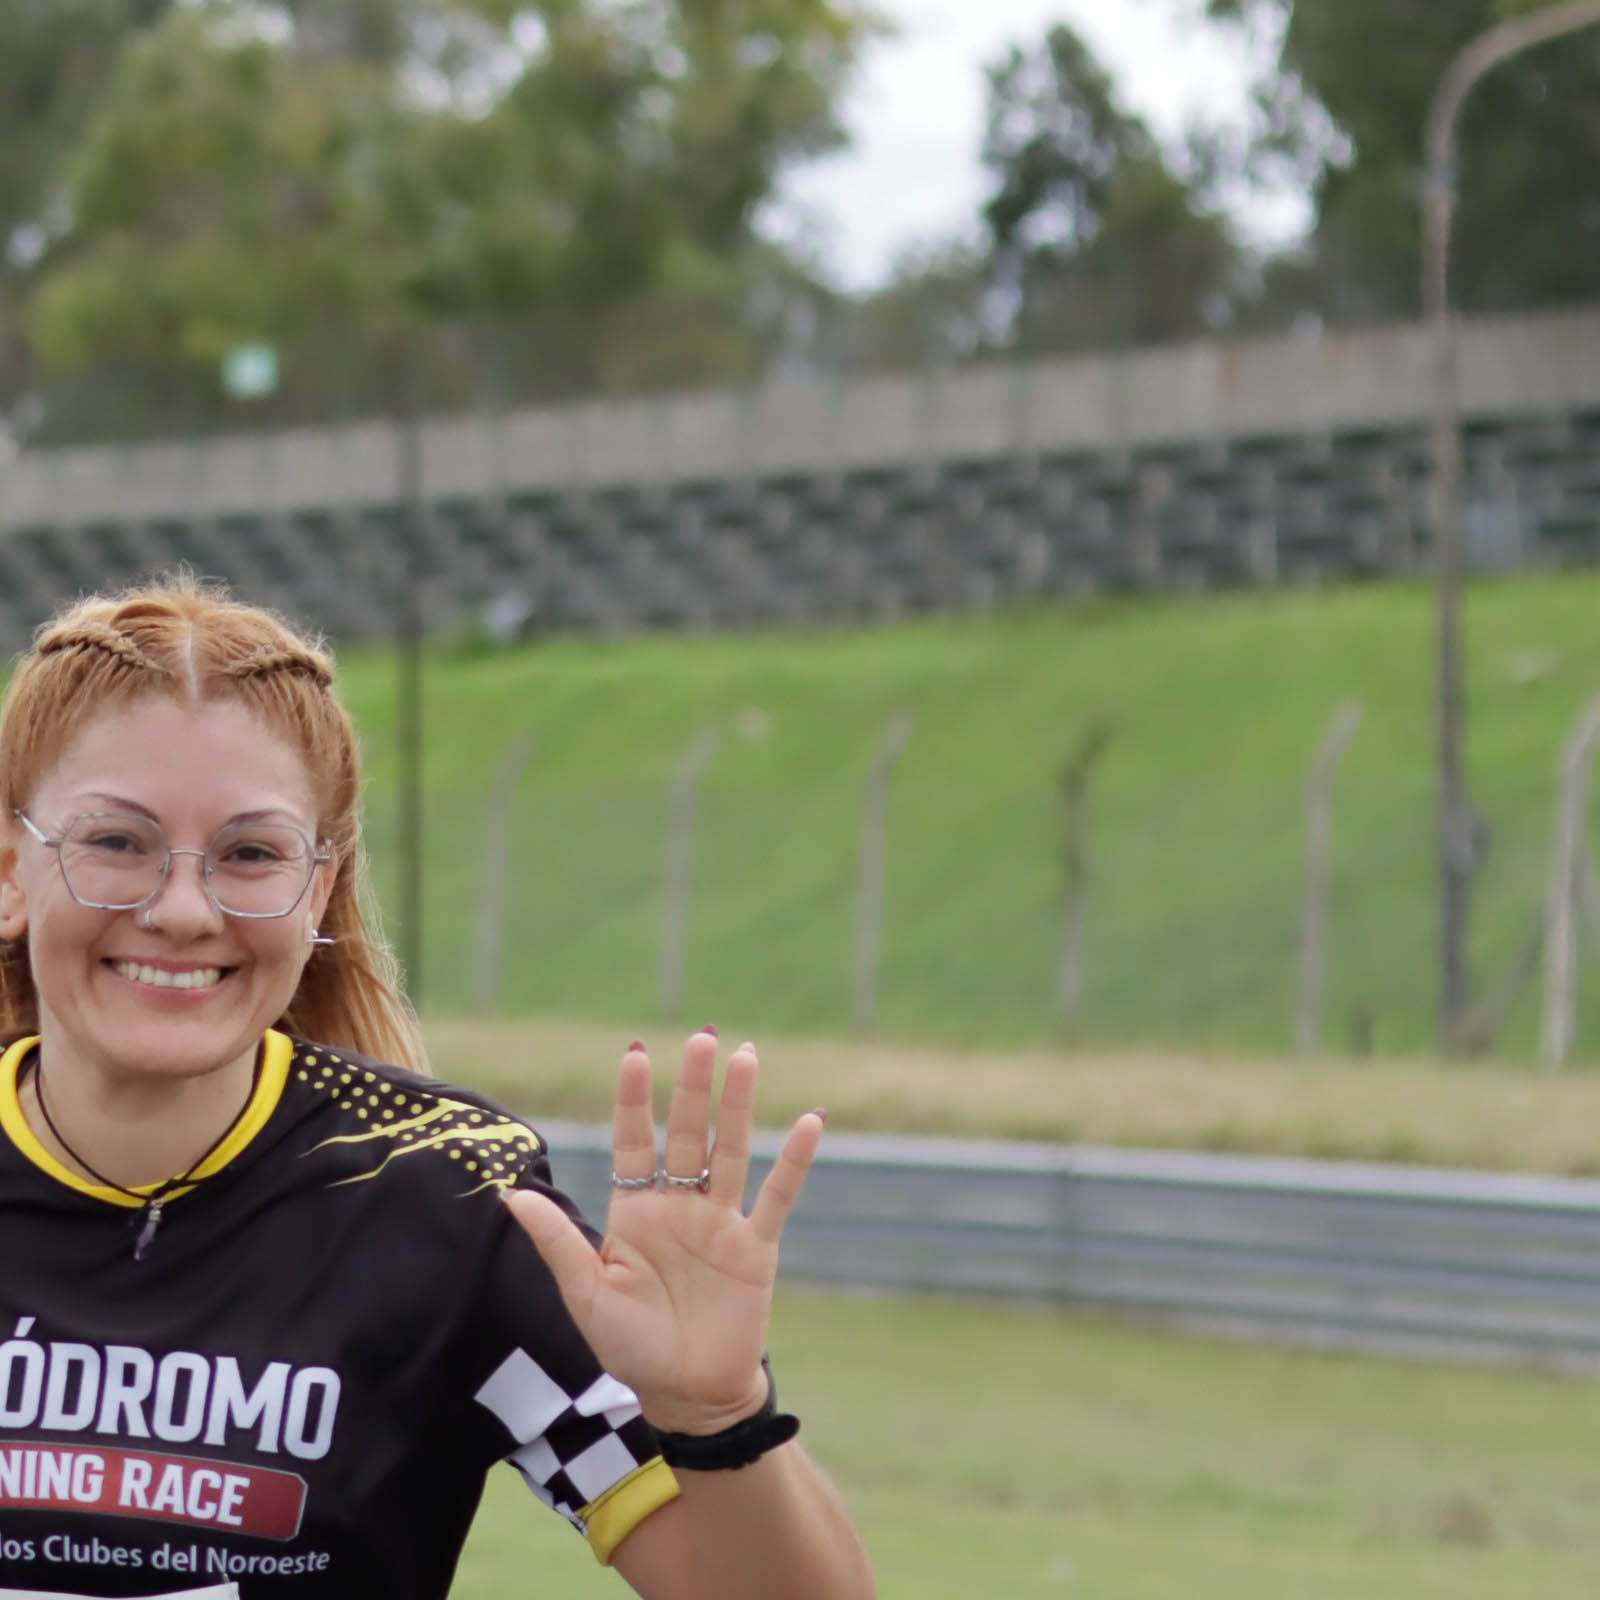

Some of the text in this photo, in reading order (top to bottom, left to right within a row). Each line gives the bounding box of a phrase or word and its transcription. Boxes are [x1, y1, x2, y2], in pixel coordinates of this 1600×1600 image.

[118, 1458, 250, 1526] RACE
[44, 1535, 142, 1567] Clubes
[152, 1543, 197, 1573] del
[206, 1547, 330, 1576] Noroeste
